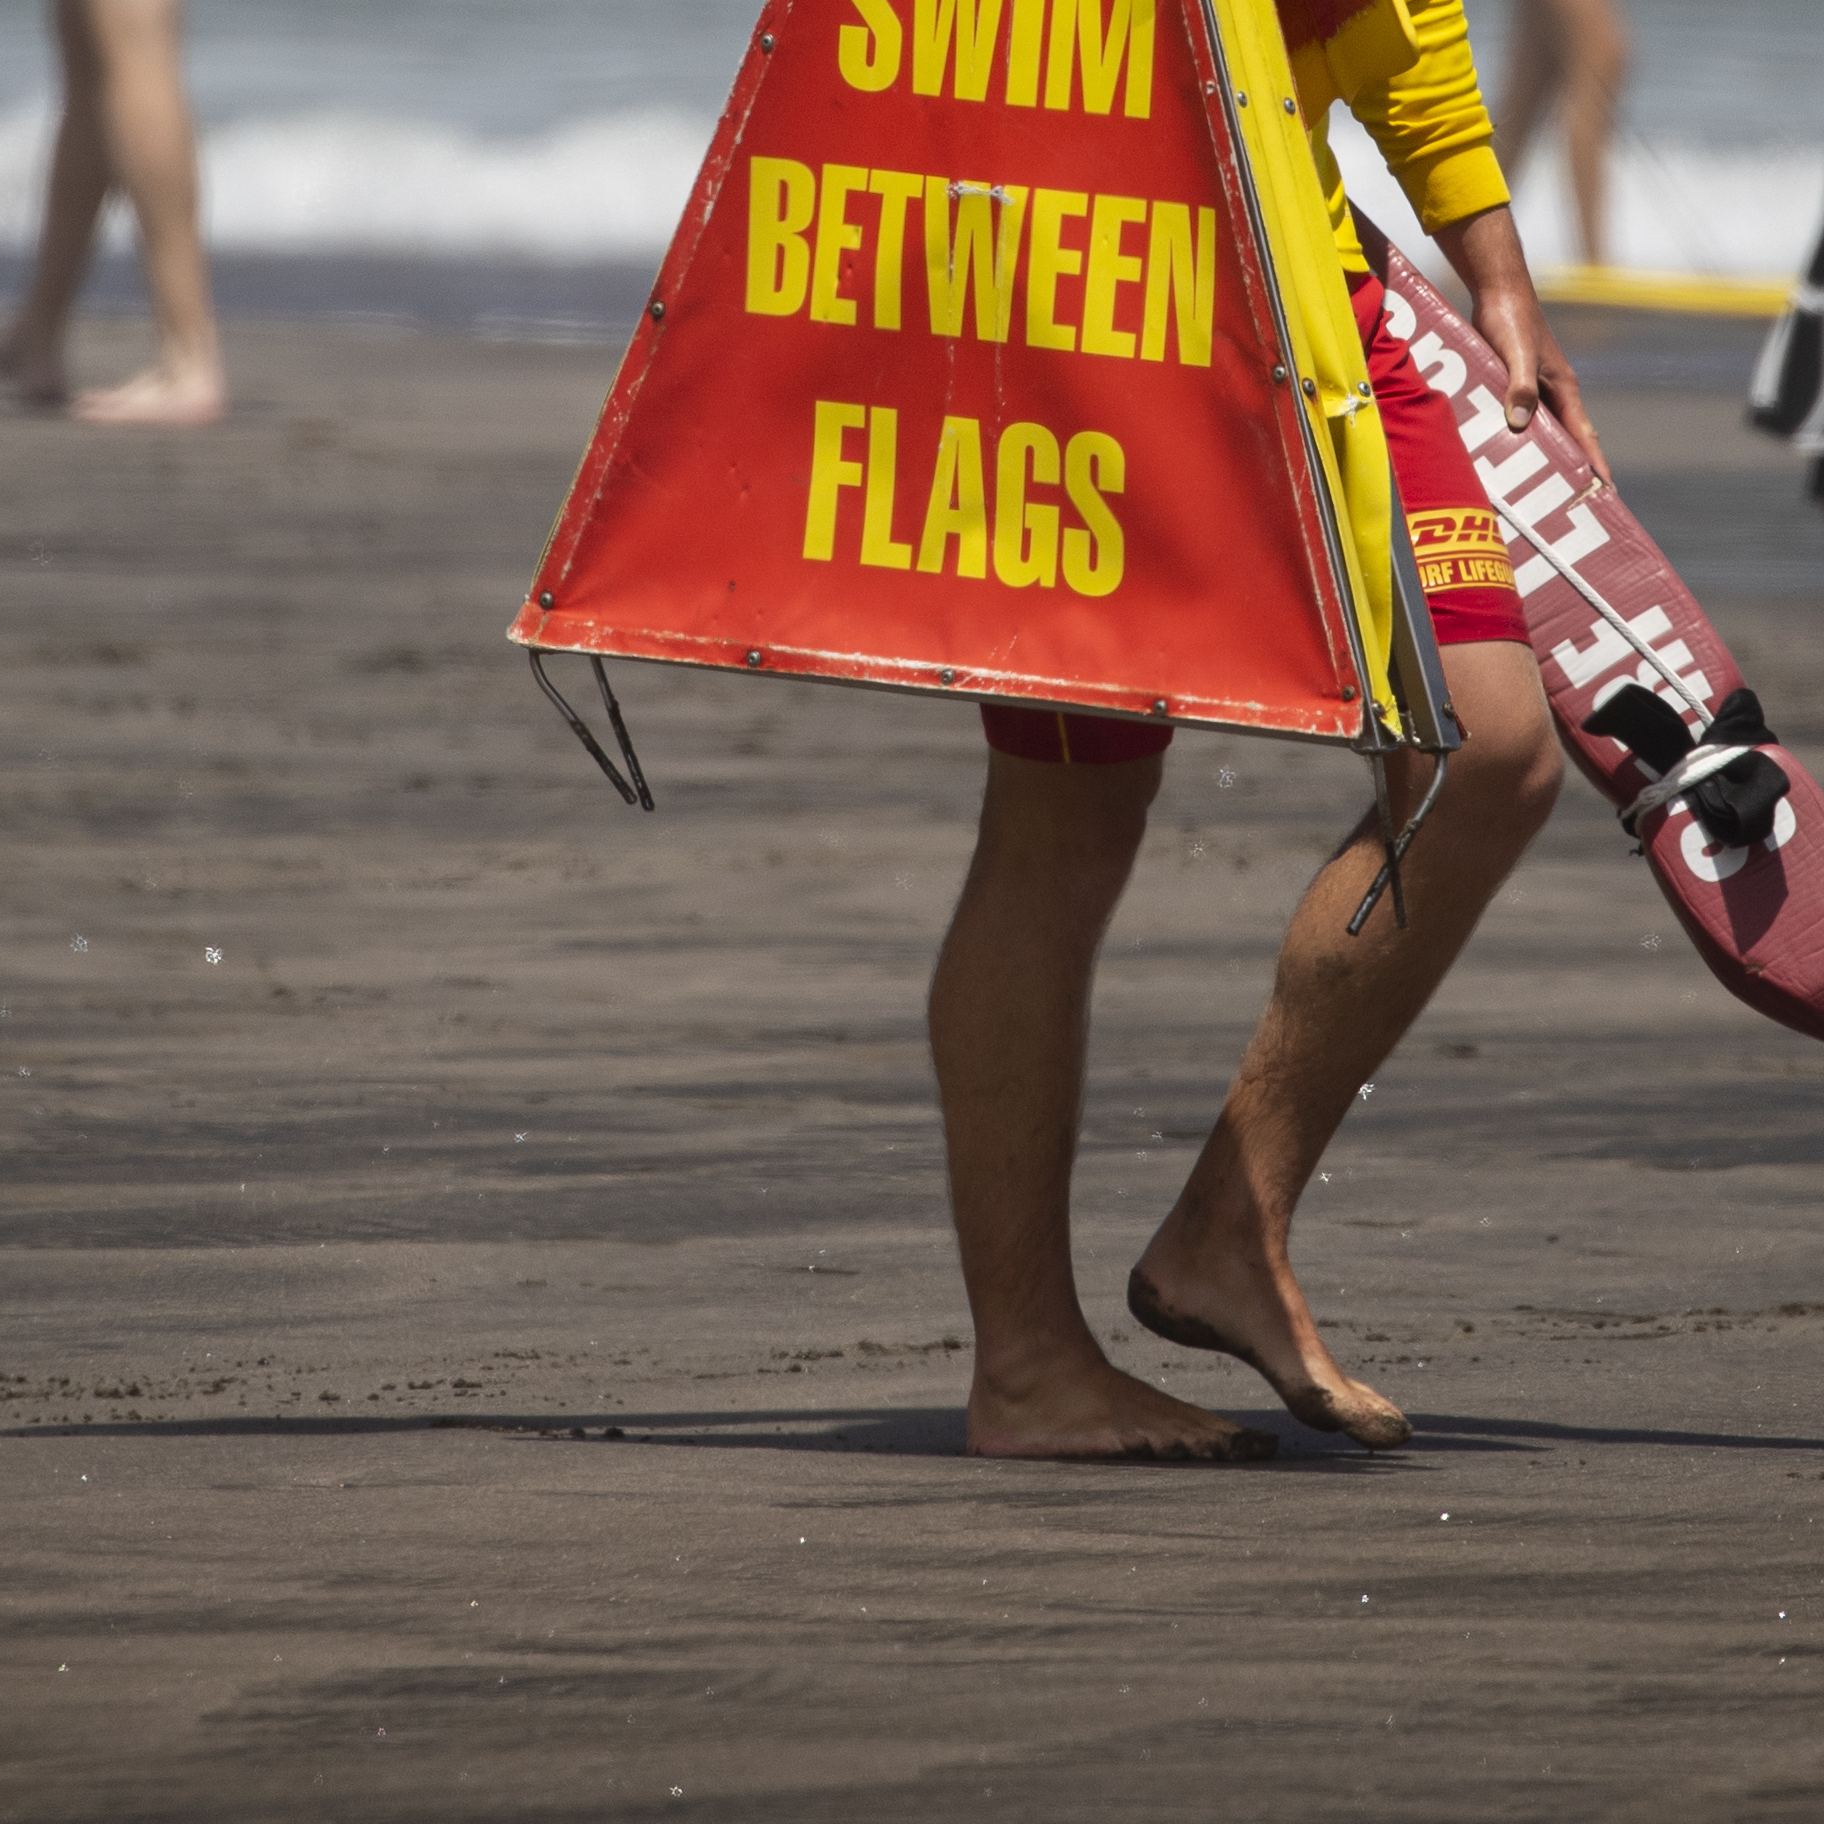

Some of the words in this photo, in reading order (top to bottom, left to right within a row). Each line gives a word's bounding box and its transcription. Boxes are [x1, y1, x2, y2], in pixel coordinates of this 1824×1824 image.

[746, 157, 1216, 366] BETWEEN
[802, 401, 1125, 596] FLAGS
[1550, 604, 1797, 883] SRF
